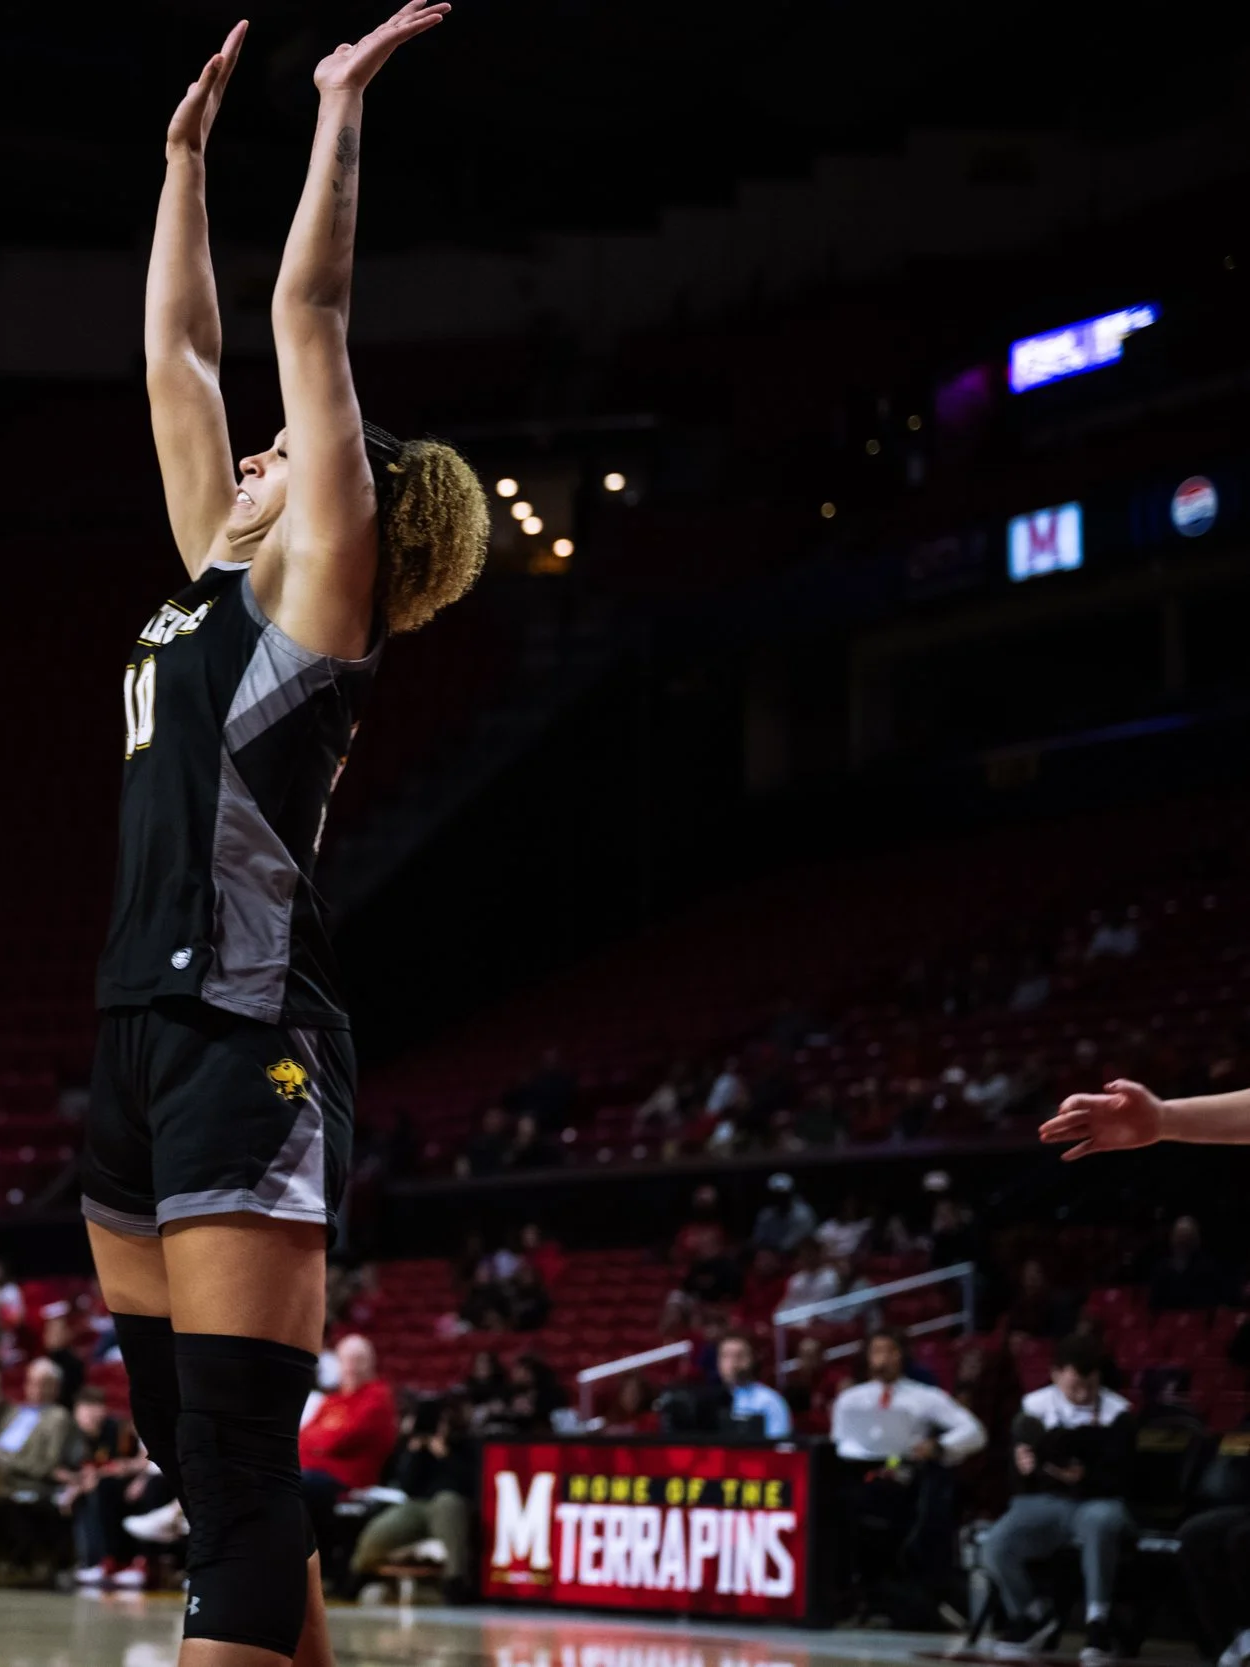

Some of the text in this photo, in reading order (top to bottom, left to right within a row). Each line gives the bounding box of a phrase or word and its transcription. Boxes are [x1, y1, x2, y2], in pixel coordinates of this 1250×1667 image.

[492, 1472, 554, 1569] M
[569, 1475, 783, 1509] HOME OF THE
[555, 1503, 797, 1598] TERRAPINS
